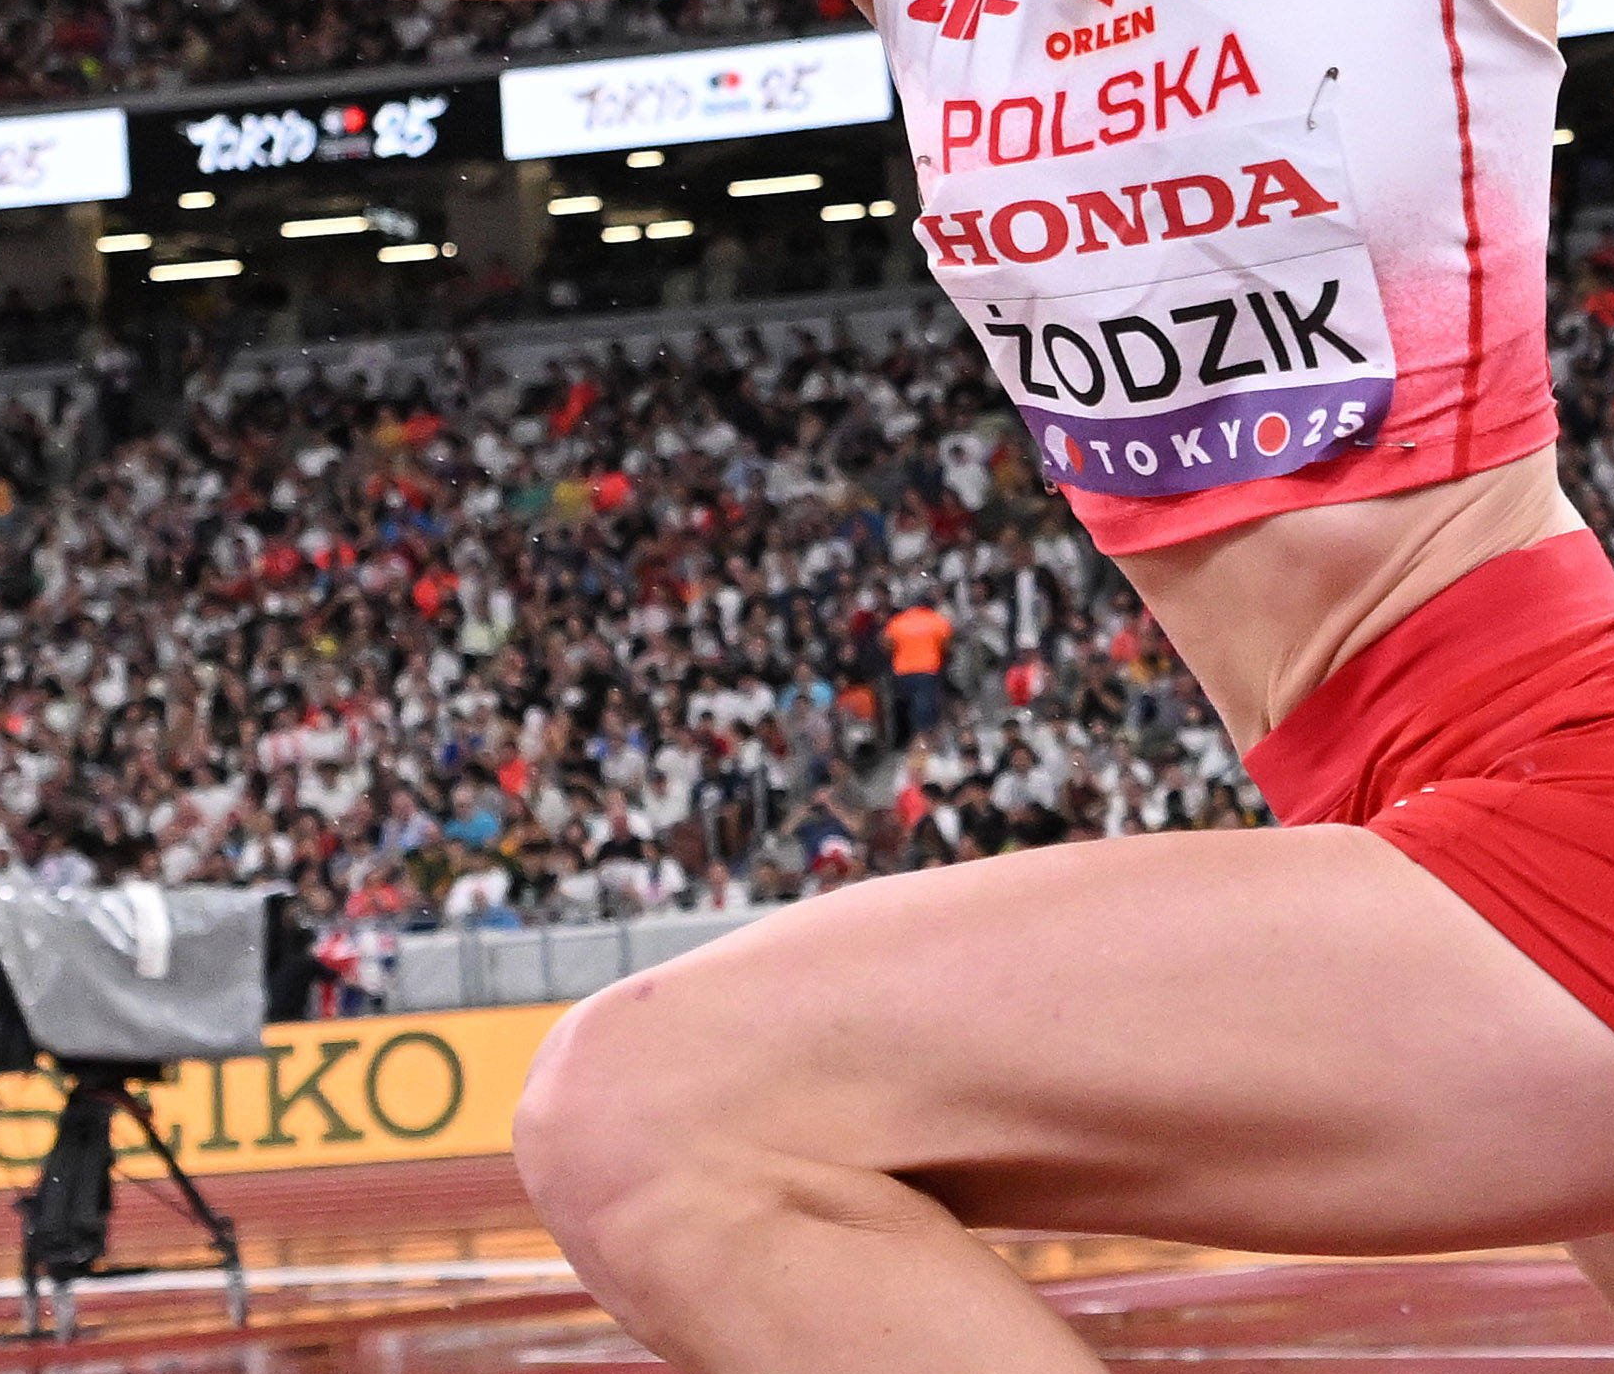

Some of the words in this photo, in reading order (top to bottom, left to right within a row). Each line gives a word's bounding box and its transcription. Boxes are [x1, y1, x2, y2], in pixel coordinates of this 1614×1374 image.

[1045, 6, 1156, 62] ORLEN
[940, 32, 1262, 175] POLSKA
[919, 159, 1339, 268] HONDA
[984, 279, 1370, 407] ŻODZIK
[1088, 409, 1292, 477] TOKYO
[1303, 400, 1367, 451] 25
